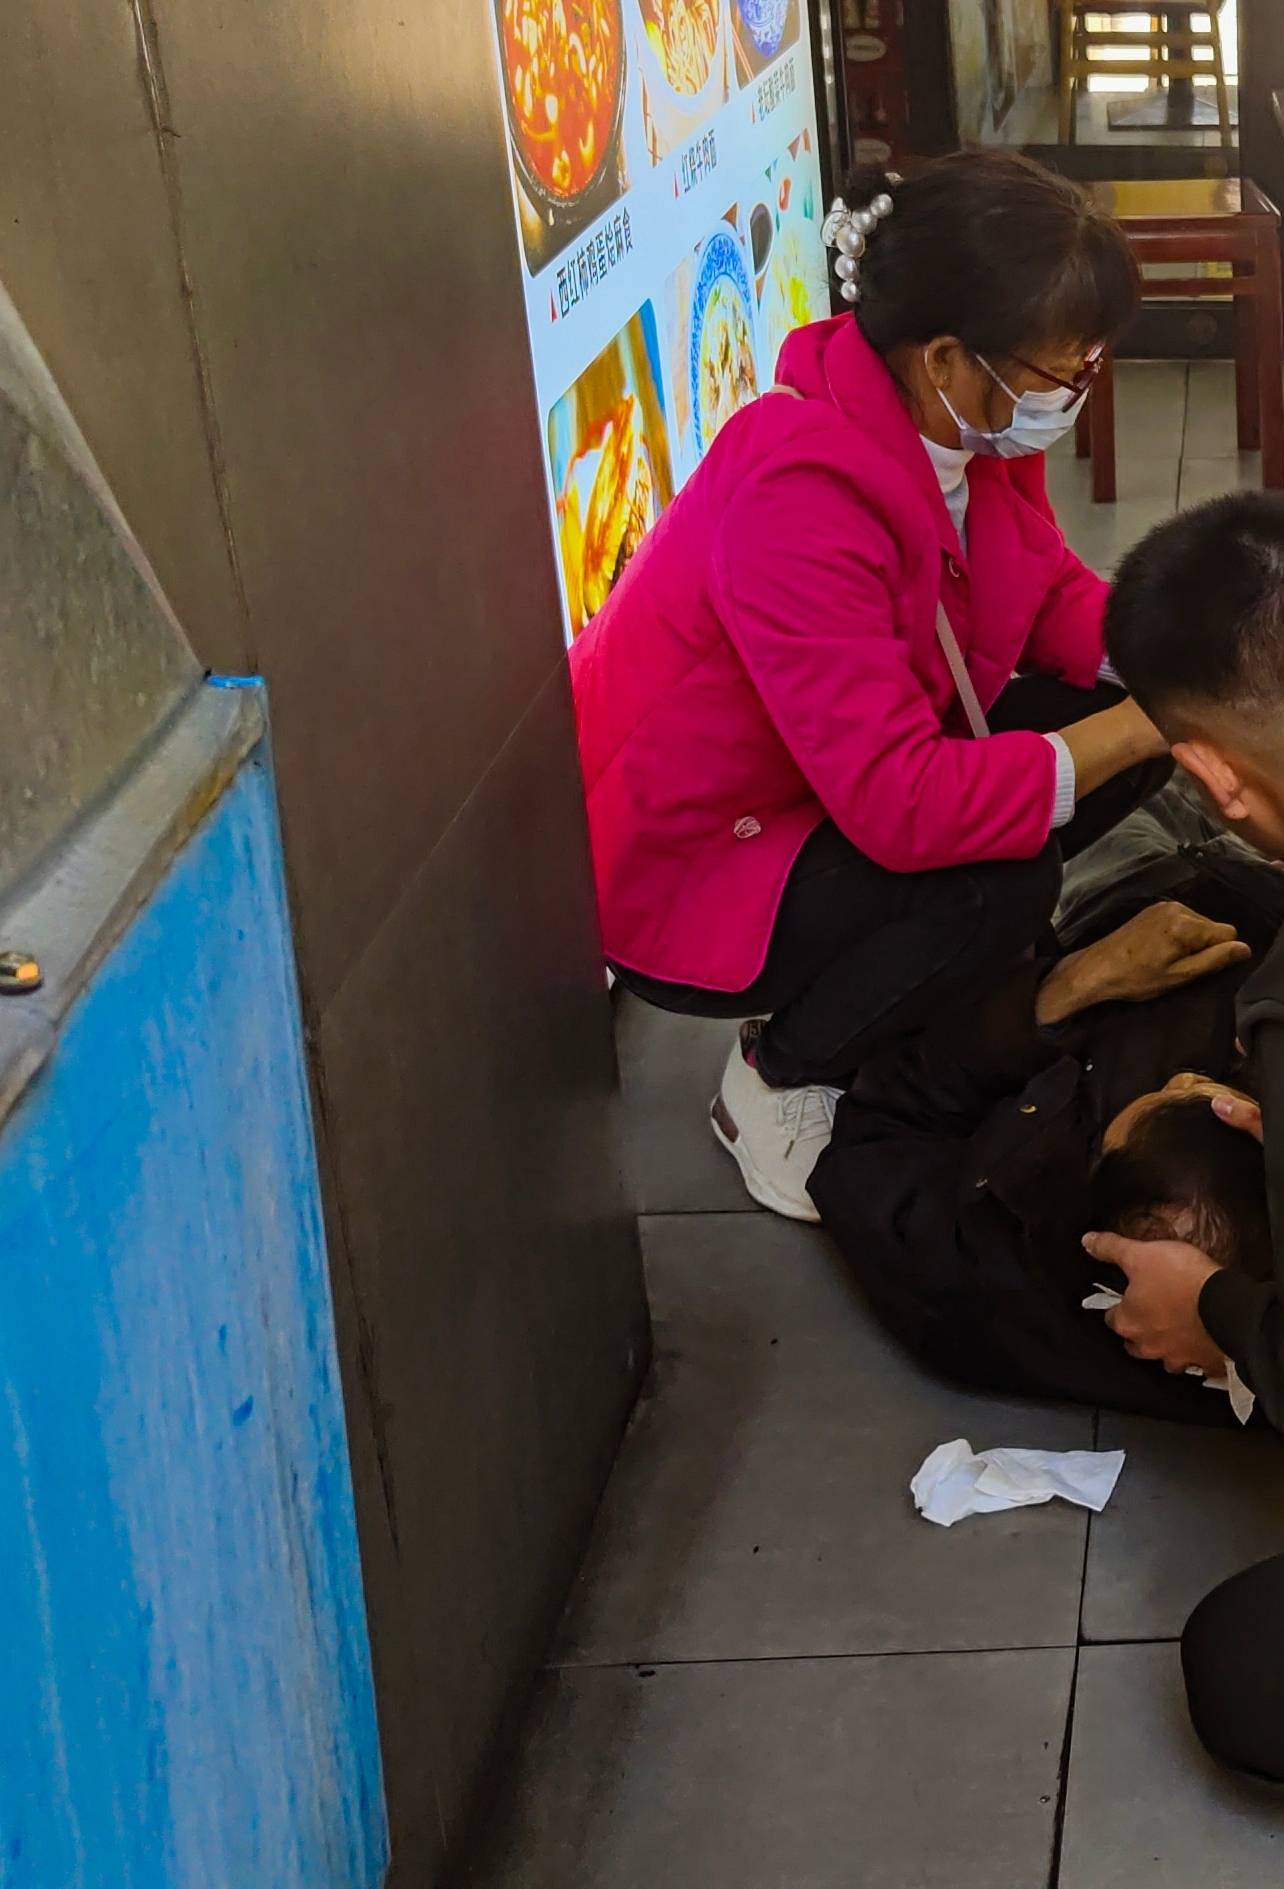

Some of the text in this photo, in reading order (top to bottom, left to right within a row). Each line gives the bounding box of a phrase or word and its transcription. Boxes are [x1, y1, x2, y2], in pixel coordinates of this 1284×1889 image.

[681, 128, 717, 193] 红烧牛肉面
[557, 206, 633, 319] 西红柿鸡蛋烩麻食
